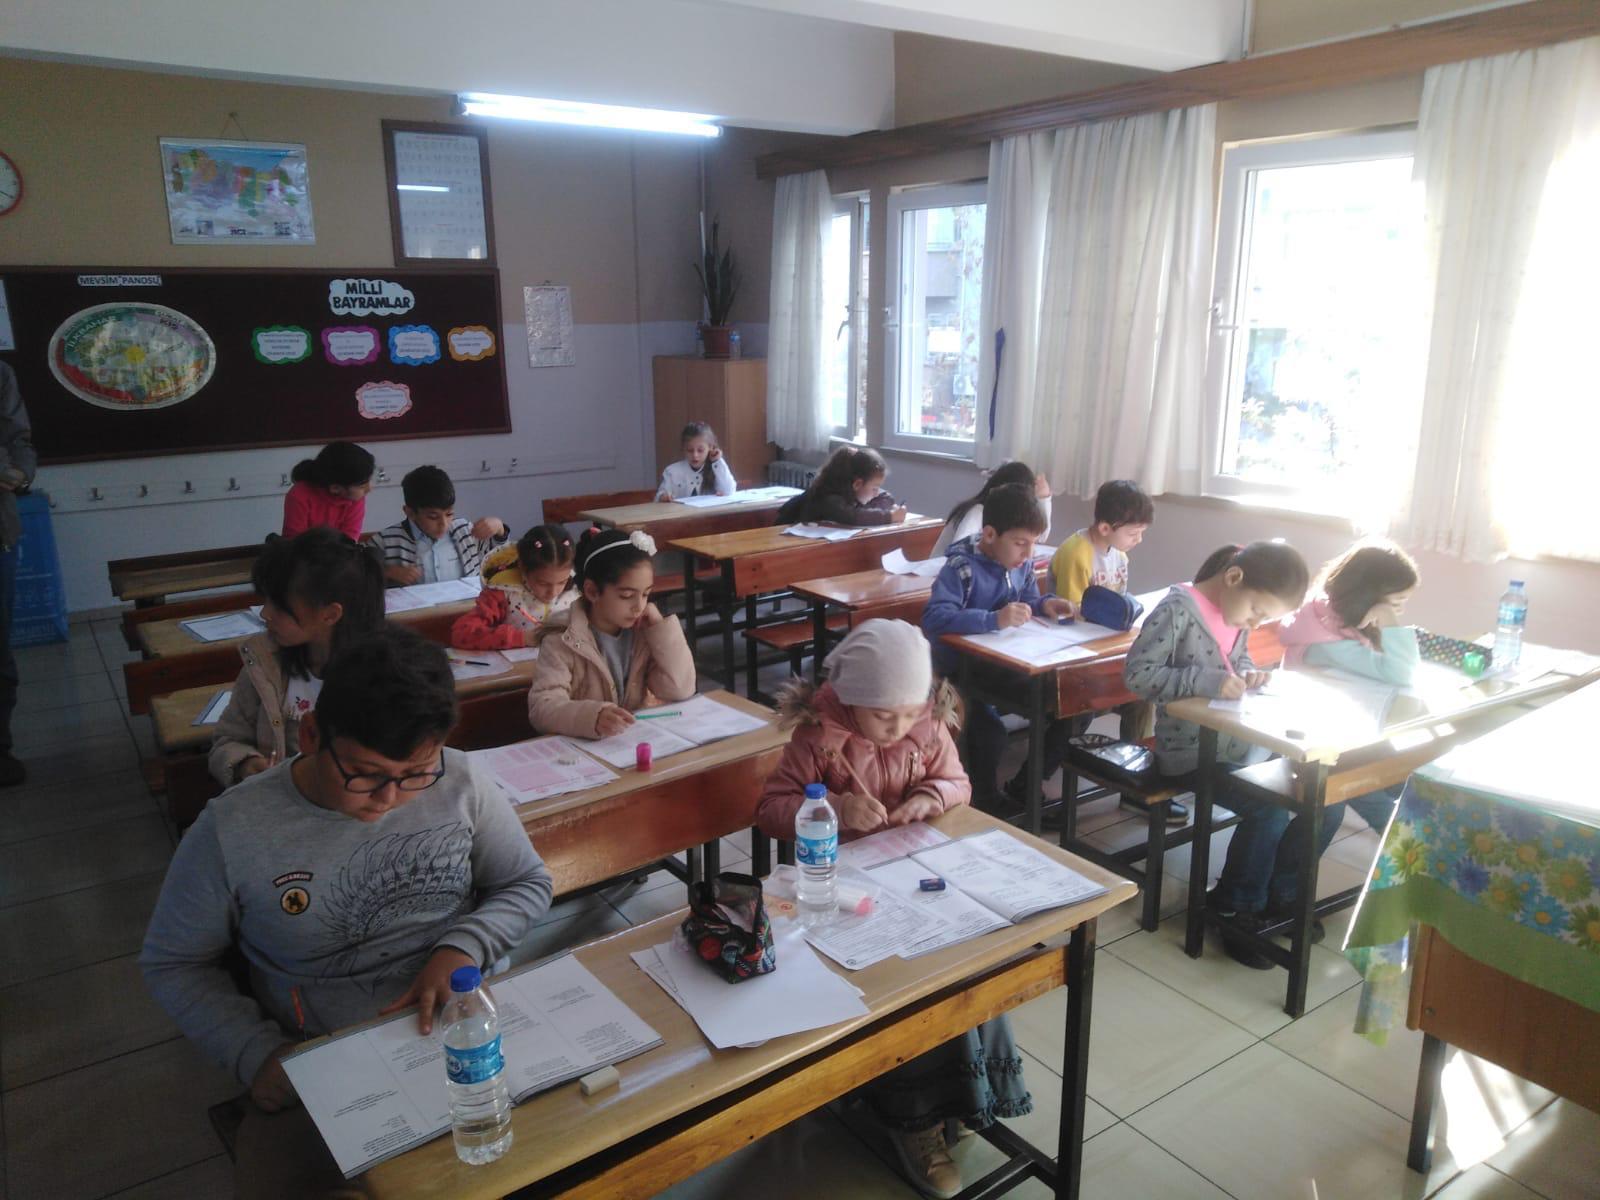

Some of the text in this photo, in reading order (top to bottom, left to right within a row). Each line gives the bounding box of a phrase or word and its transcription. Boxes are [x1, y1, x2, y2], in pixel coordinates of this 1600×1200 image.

[80, 275, 160, 285] MEVSİM PANOSU
[346, 280, 382, 294] MİLLİ
[333, 297, 410, 309] BAYRAMLAR
